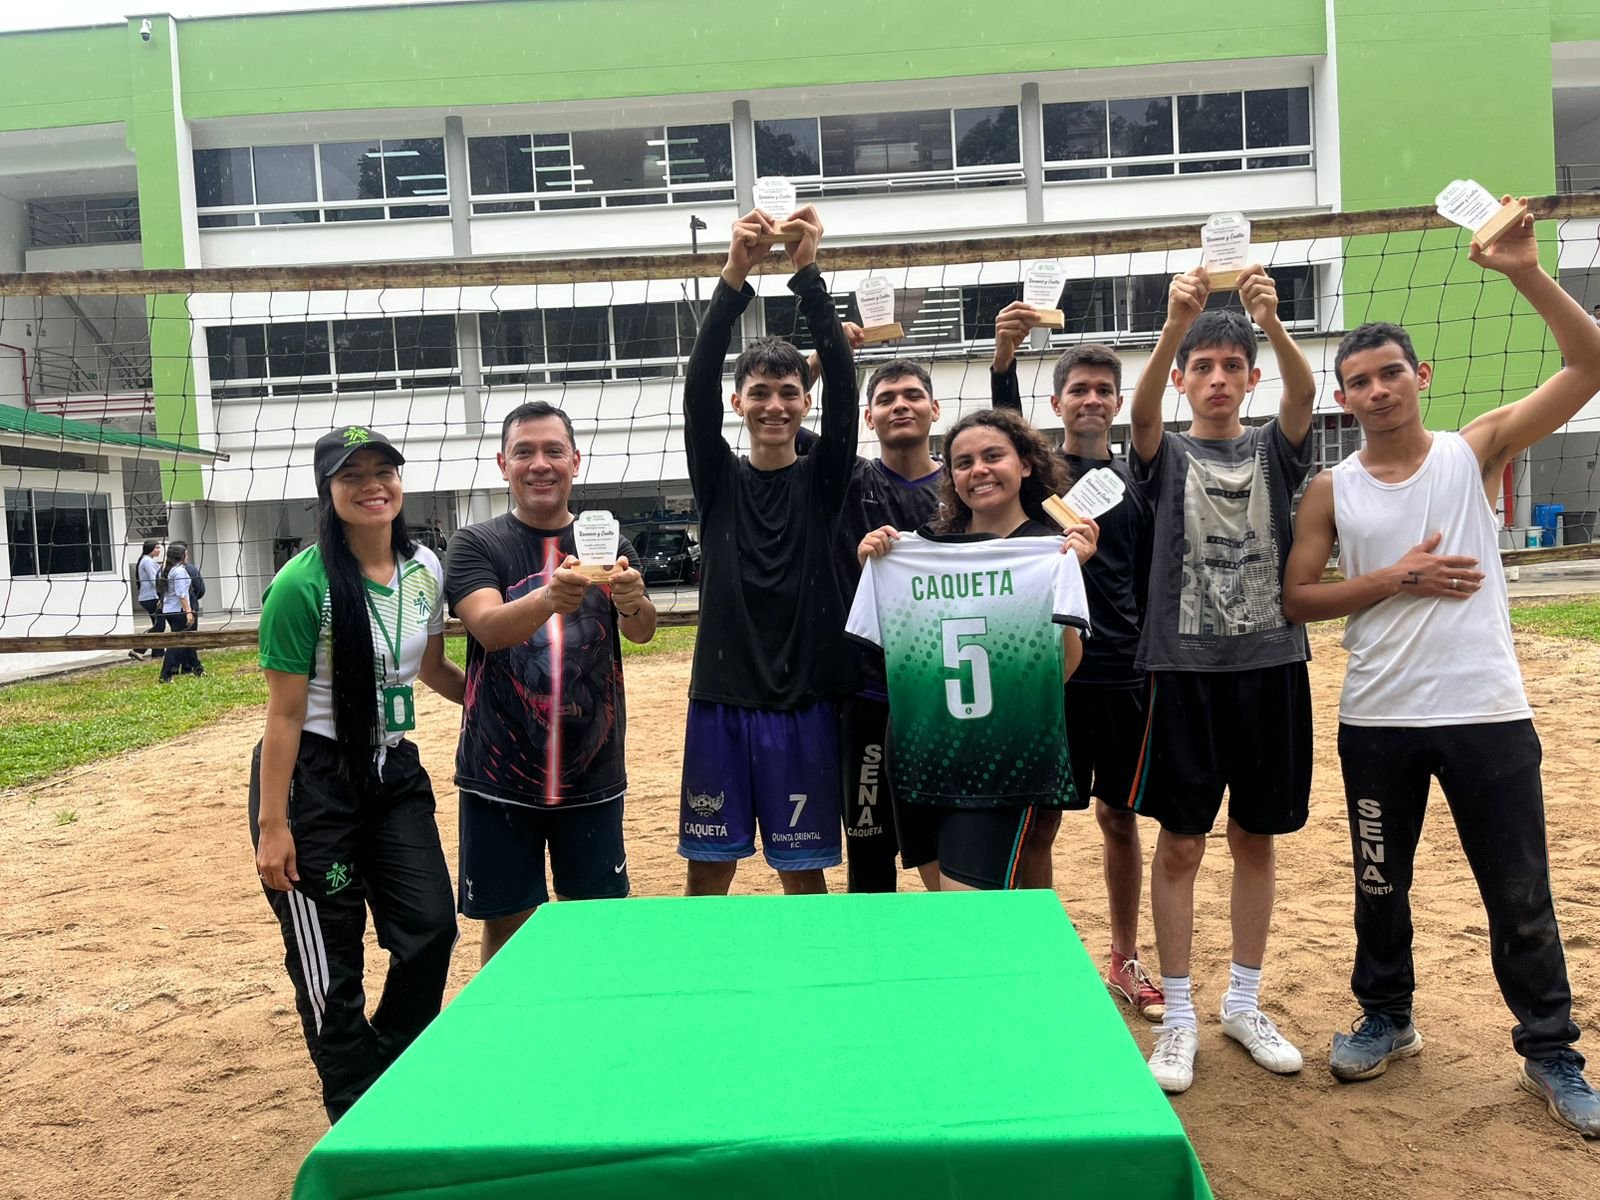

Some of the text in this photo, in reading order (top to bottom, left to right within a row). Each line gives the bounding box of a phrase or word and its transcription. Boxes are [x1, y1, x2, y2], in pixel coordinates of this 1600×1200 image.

[911, 567, 1014, 601] CAQUETÁ
[940, 616, 993, 720] 5
[857, 744, 882, 827] SENA
[789, 794, 807, 828] 7
[685, 822, 728, 838] CAQUETÁ
[772, 831, 821, 843] QUINTA ORIENTAL
[1357, 798, 1385, 884] SENA
